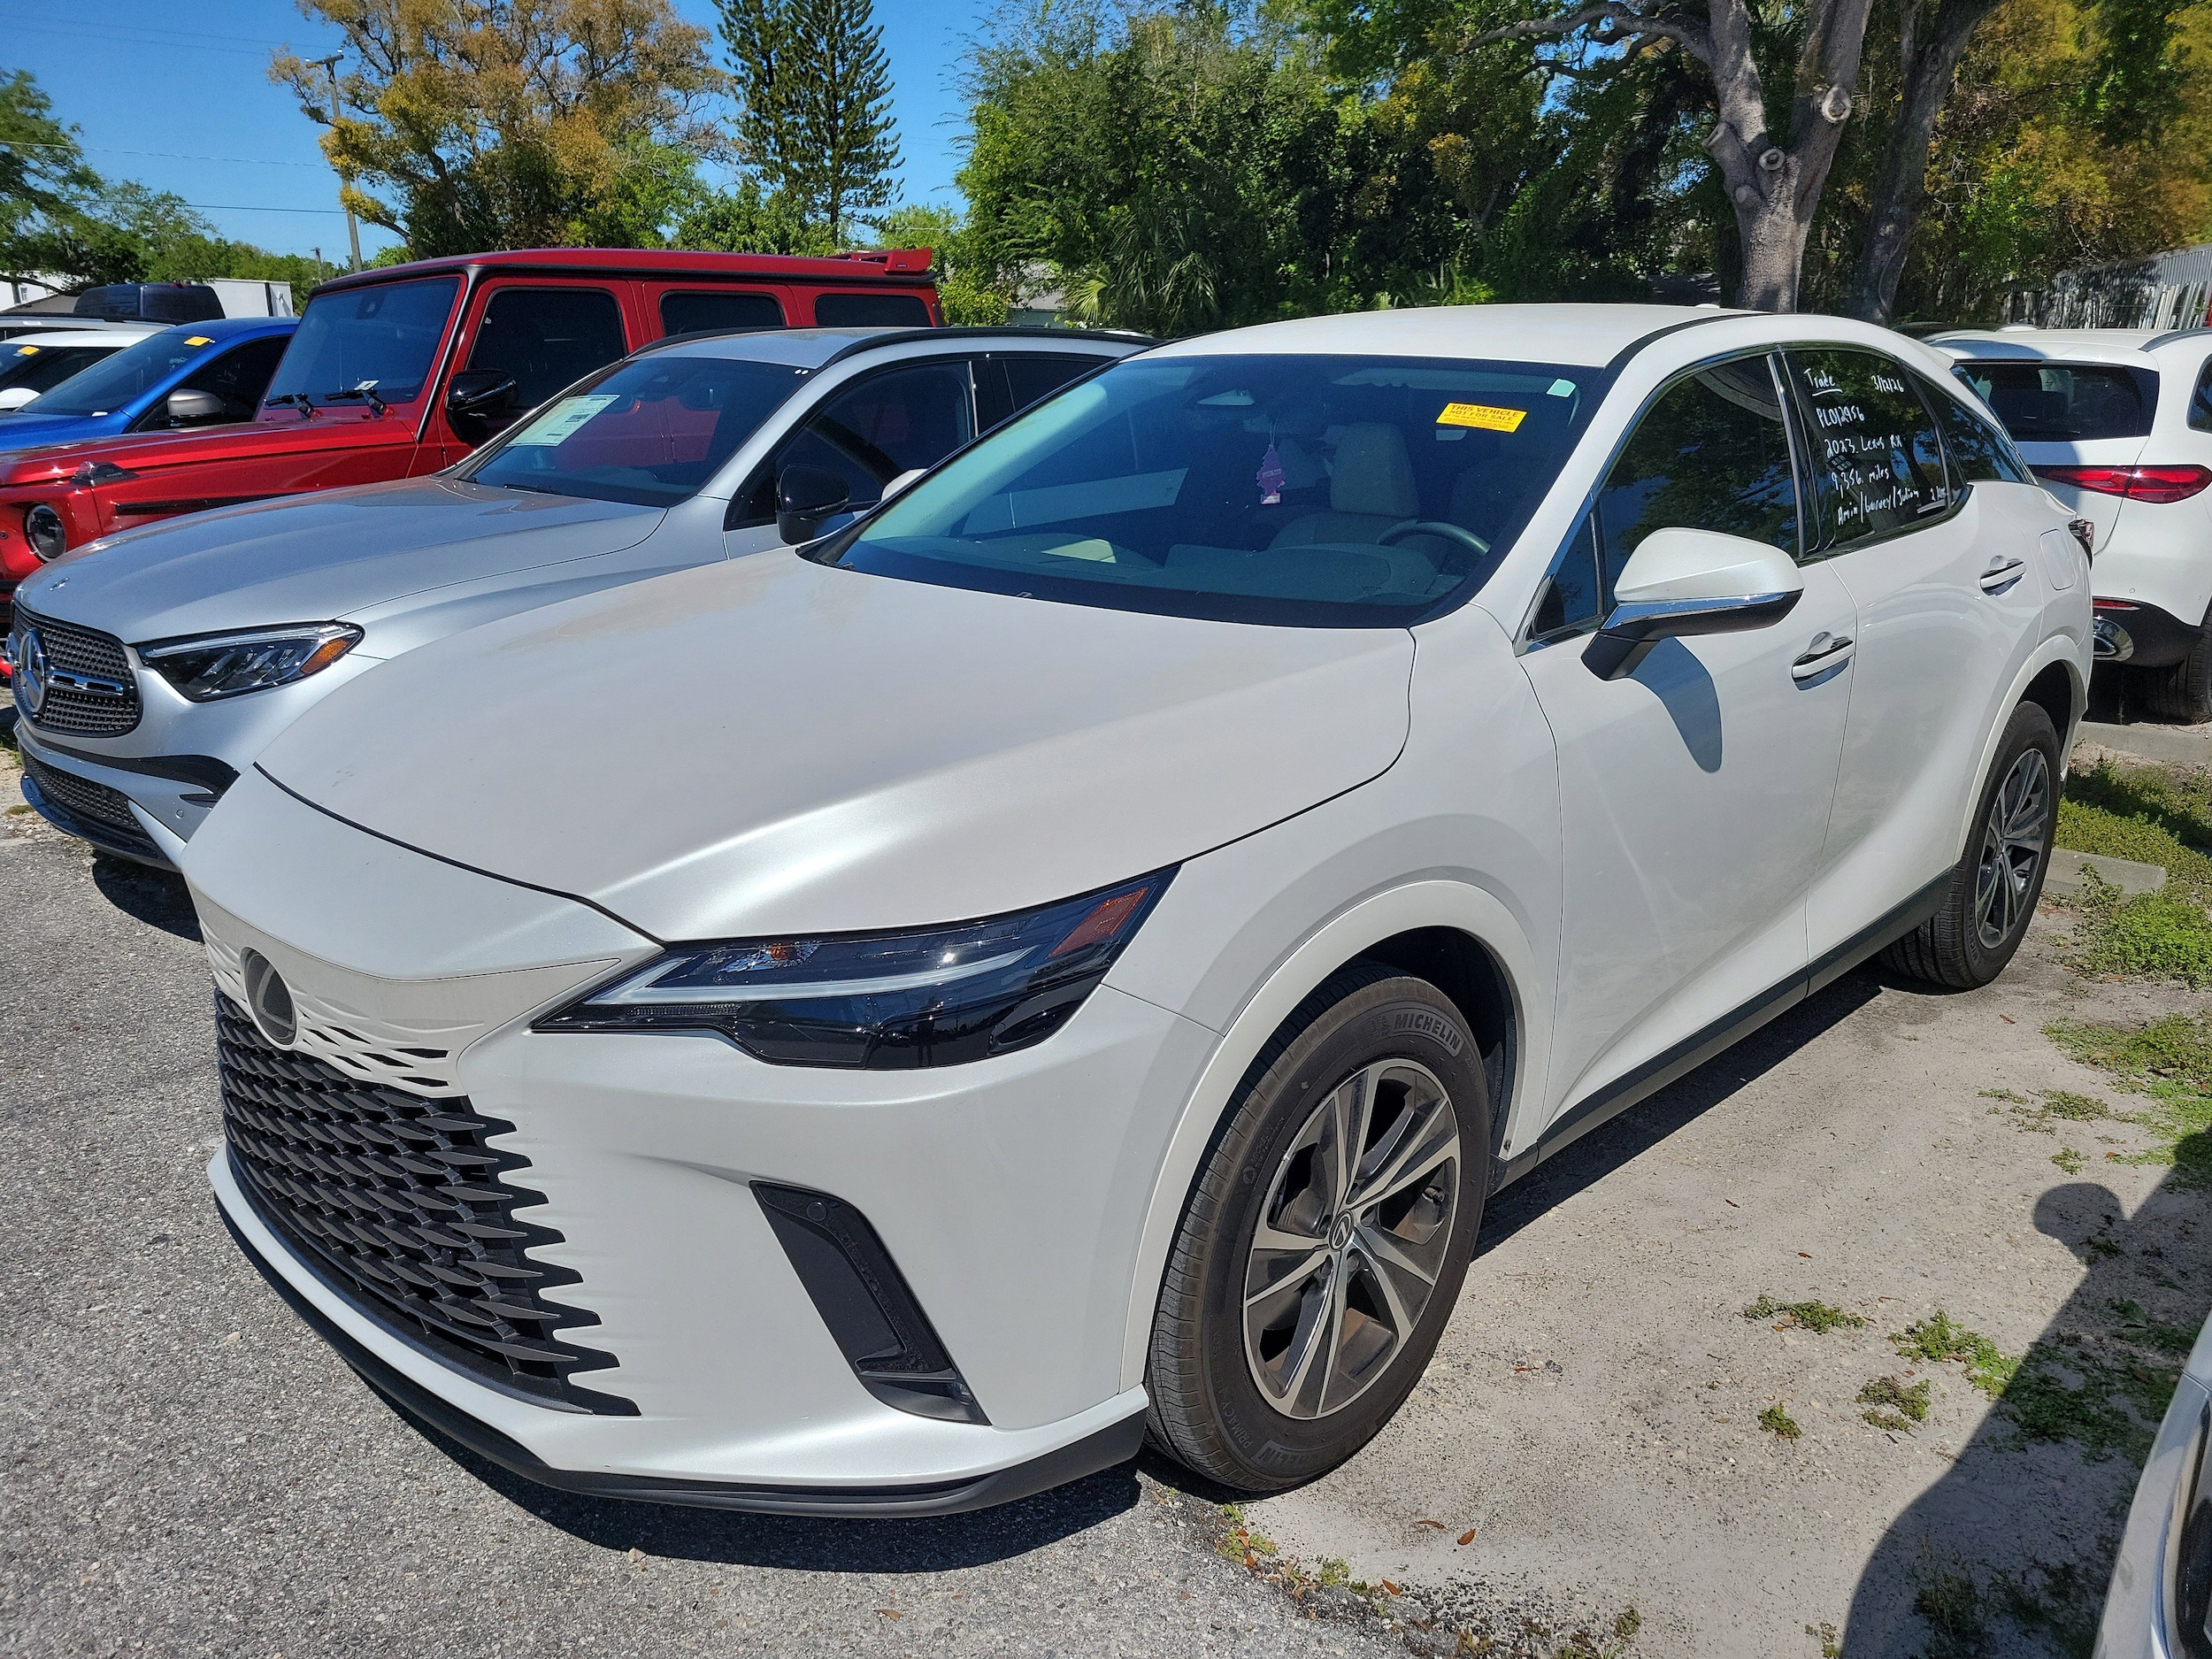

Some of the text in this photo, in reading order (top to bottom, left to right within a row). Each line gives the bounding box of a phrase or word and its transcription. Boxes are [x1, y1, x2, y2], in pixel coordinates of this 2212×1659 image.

[1803, 367, 1836, 389] Trade
[1871, 374, 1904, 393] 3/12/26
[1477, 407, 1520, 418] VEHICLE
[1860, 435, 1885, 451] Lexus
[1890, 434, 1903, 449] RX
[1869, 464, 1890, 484] miles
[1394, 1012, 1461, 1050] MICHELIN
[1222, 1401, 1251, 1449] PRIMACY
